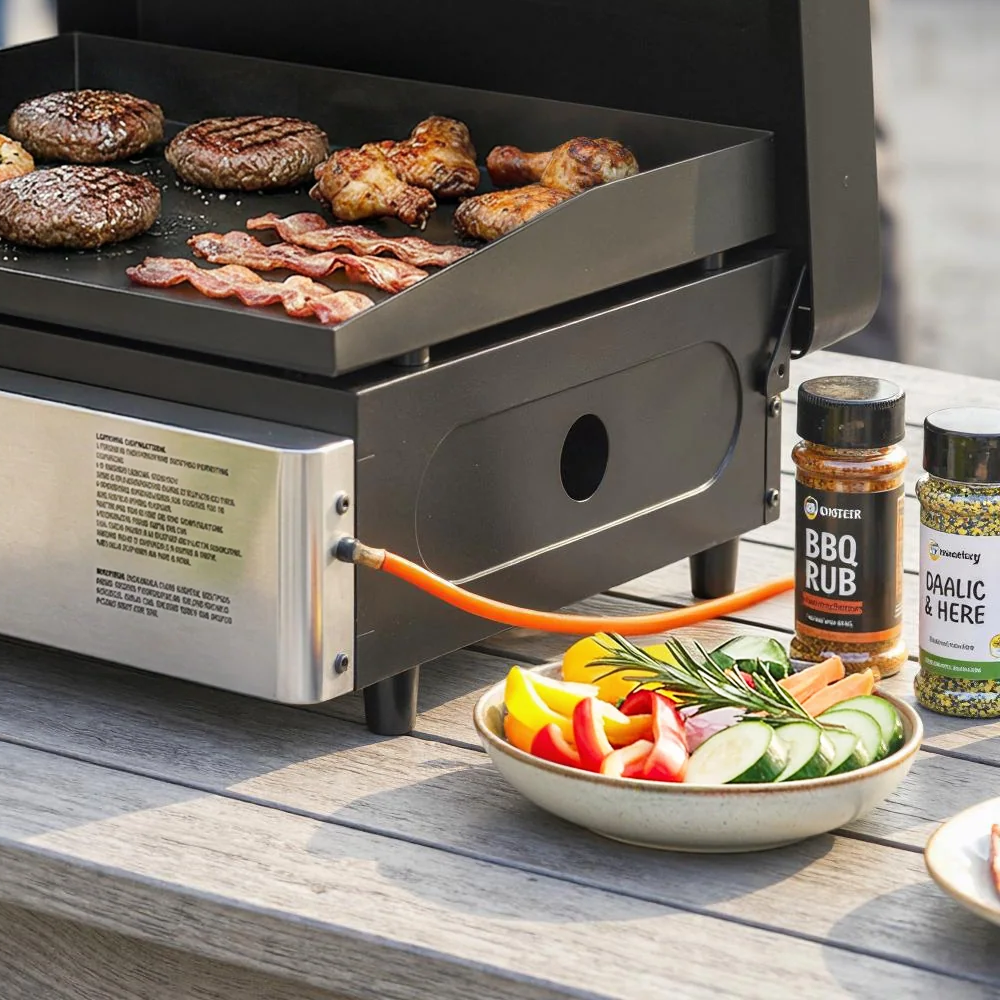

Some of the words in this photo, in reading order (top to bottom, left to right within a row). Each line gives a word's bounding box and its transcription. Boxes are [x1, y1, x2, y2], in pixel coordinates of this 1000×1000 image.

[805, 527, 858, 567] BBQ
[805, 559, 857, 596] RUB
[926, 570, 986, 601] DAALIC
[925, 595, 932, 617] &
[938, 599, 985, 625] HERE
